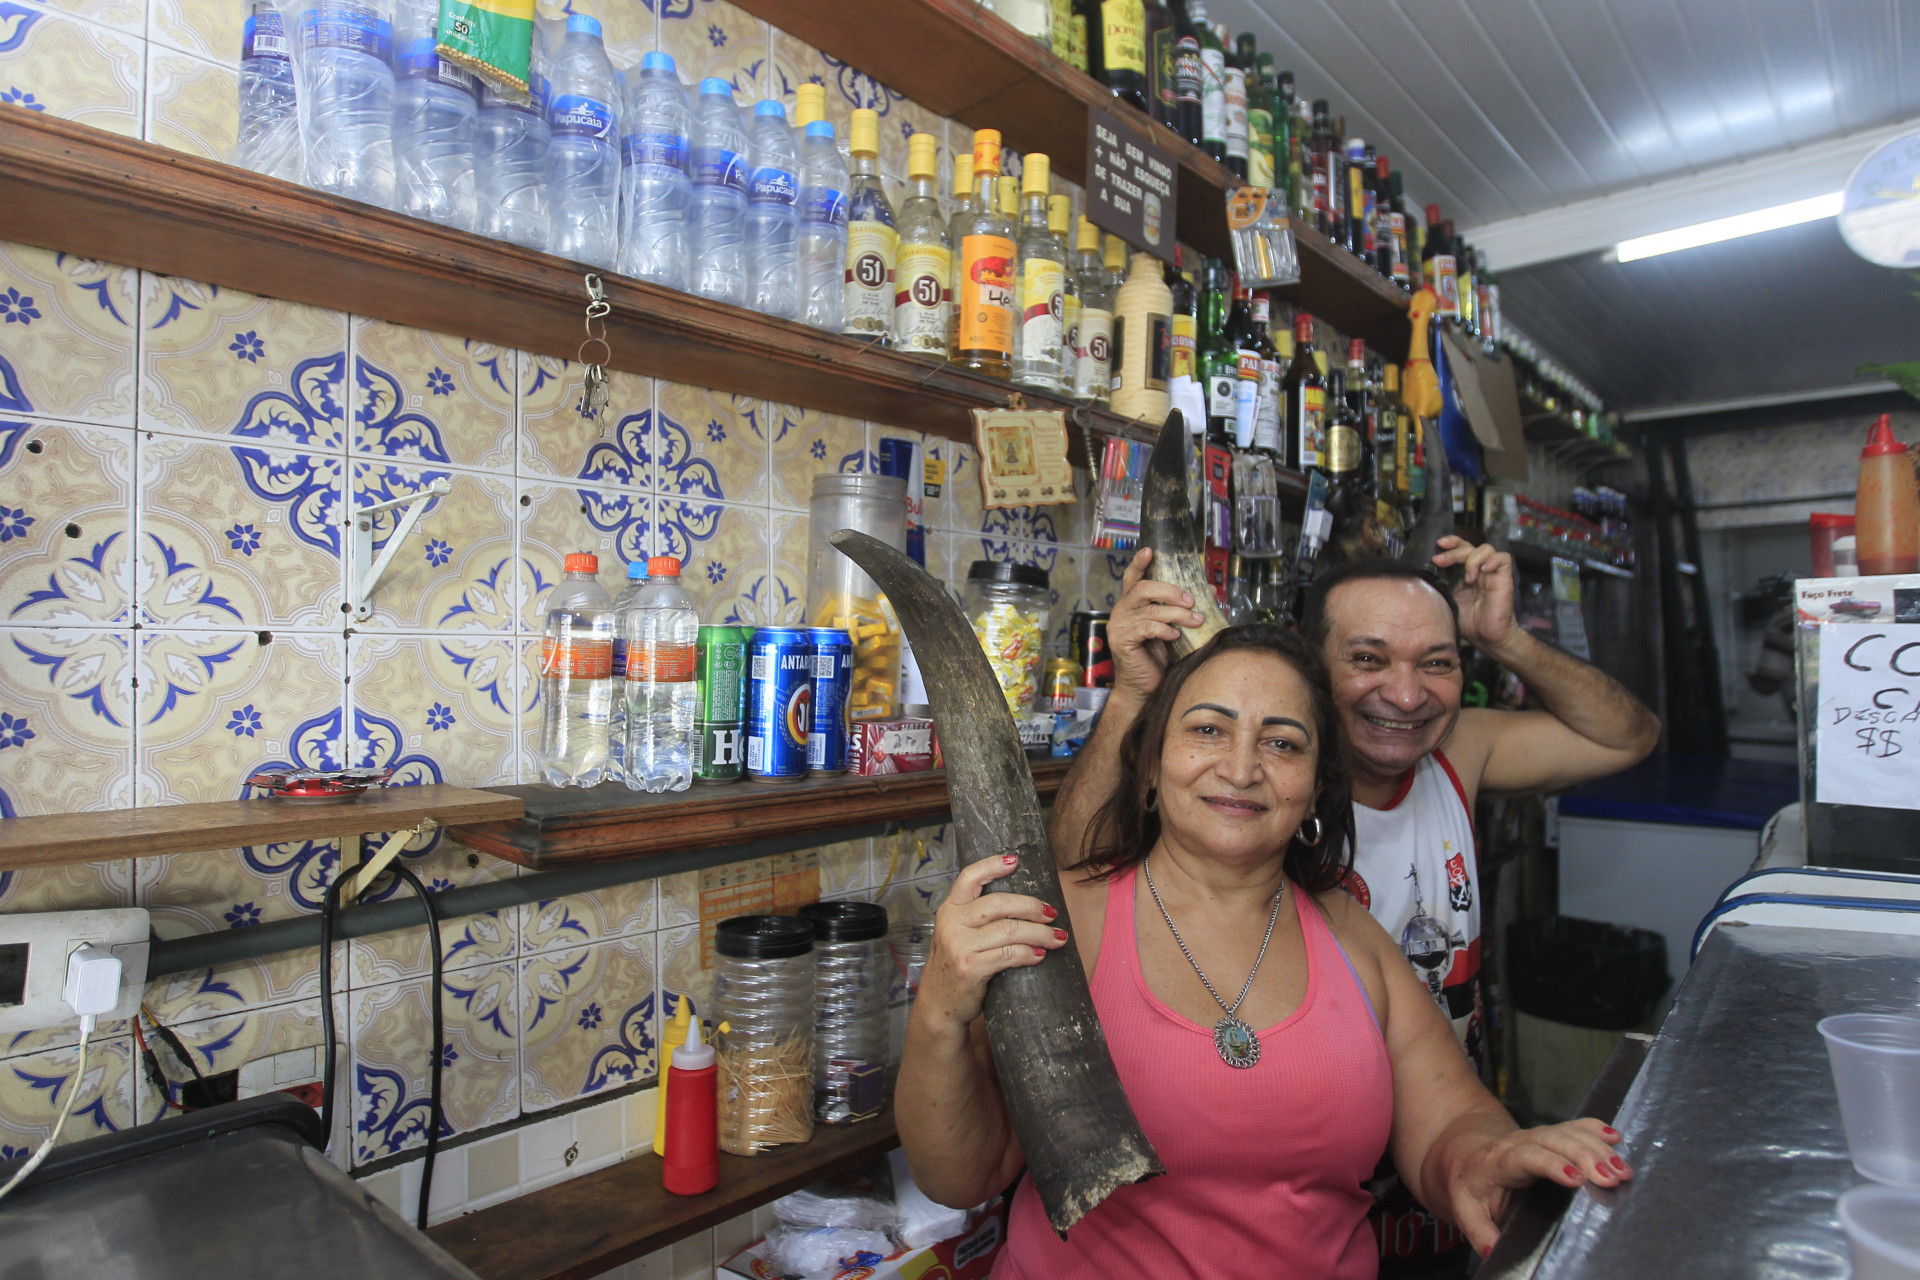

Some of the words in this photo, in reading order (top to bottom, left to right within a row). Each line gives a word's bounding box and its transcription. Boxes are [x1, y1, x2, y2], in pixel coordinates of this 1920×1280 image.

[454, 21, 469, 36] 50
[554, 112, 603, 129] Papucaia
[1096, 123, 1119, 148] SEJA
[1125, 141, 1144, 164] BEM
[1148, 155, 1172, 181] VINDO
[1095, 163, 1107, 180] DE
[1110, 172, 1142, 201] TRAZER
[1109, 151, 1127, 172] NÃO
[1134, 165, 1171, 197] ESQUEÇA
[755, 183, 796, 197] Papucaia
[1100, 187, 1108, 201] A
[1113, 194, 1132, 214] SUA
[861, 258, 881, 283] 51
[918, 279, 937, 302] 51
[1094, 338, 1107, 359] 51
[1802, 591, 1824, 601] Faço
[1827, 589, 1853, 598] Frete
